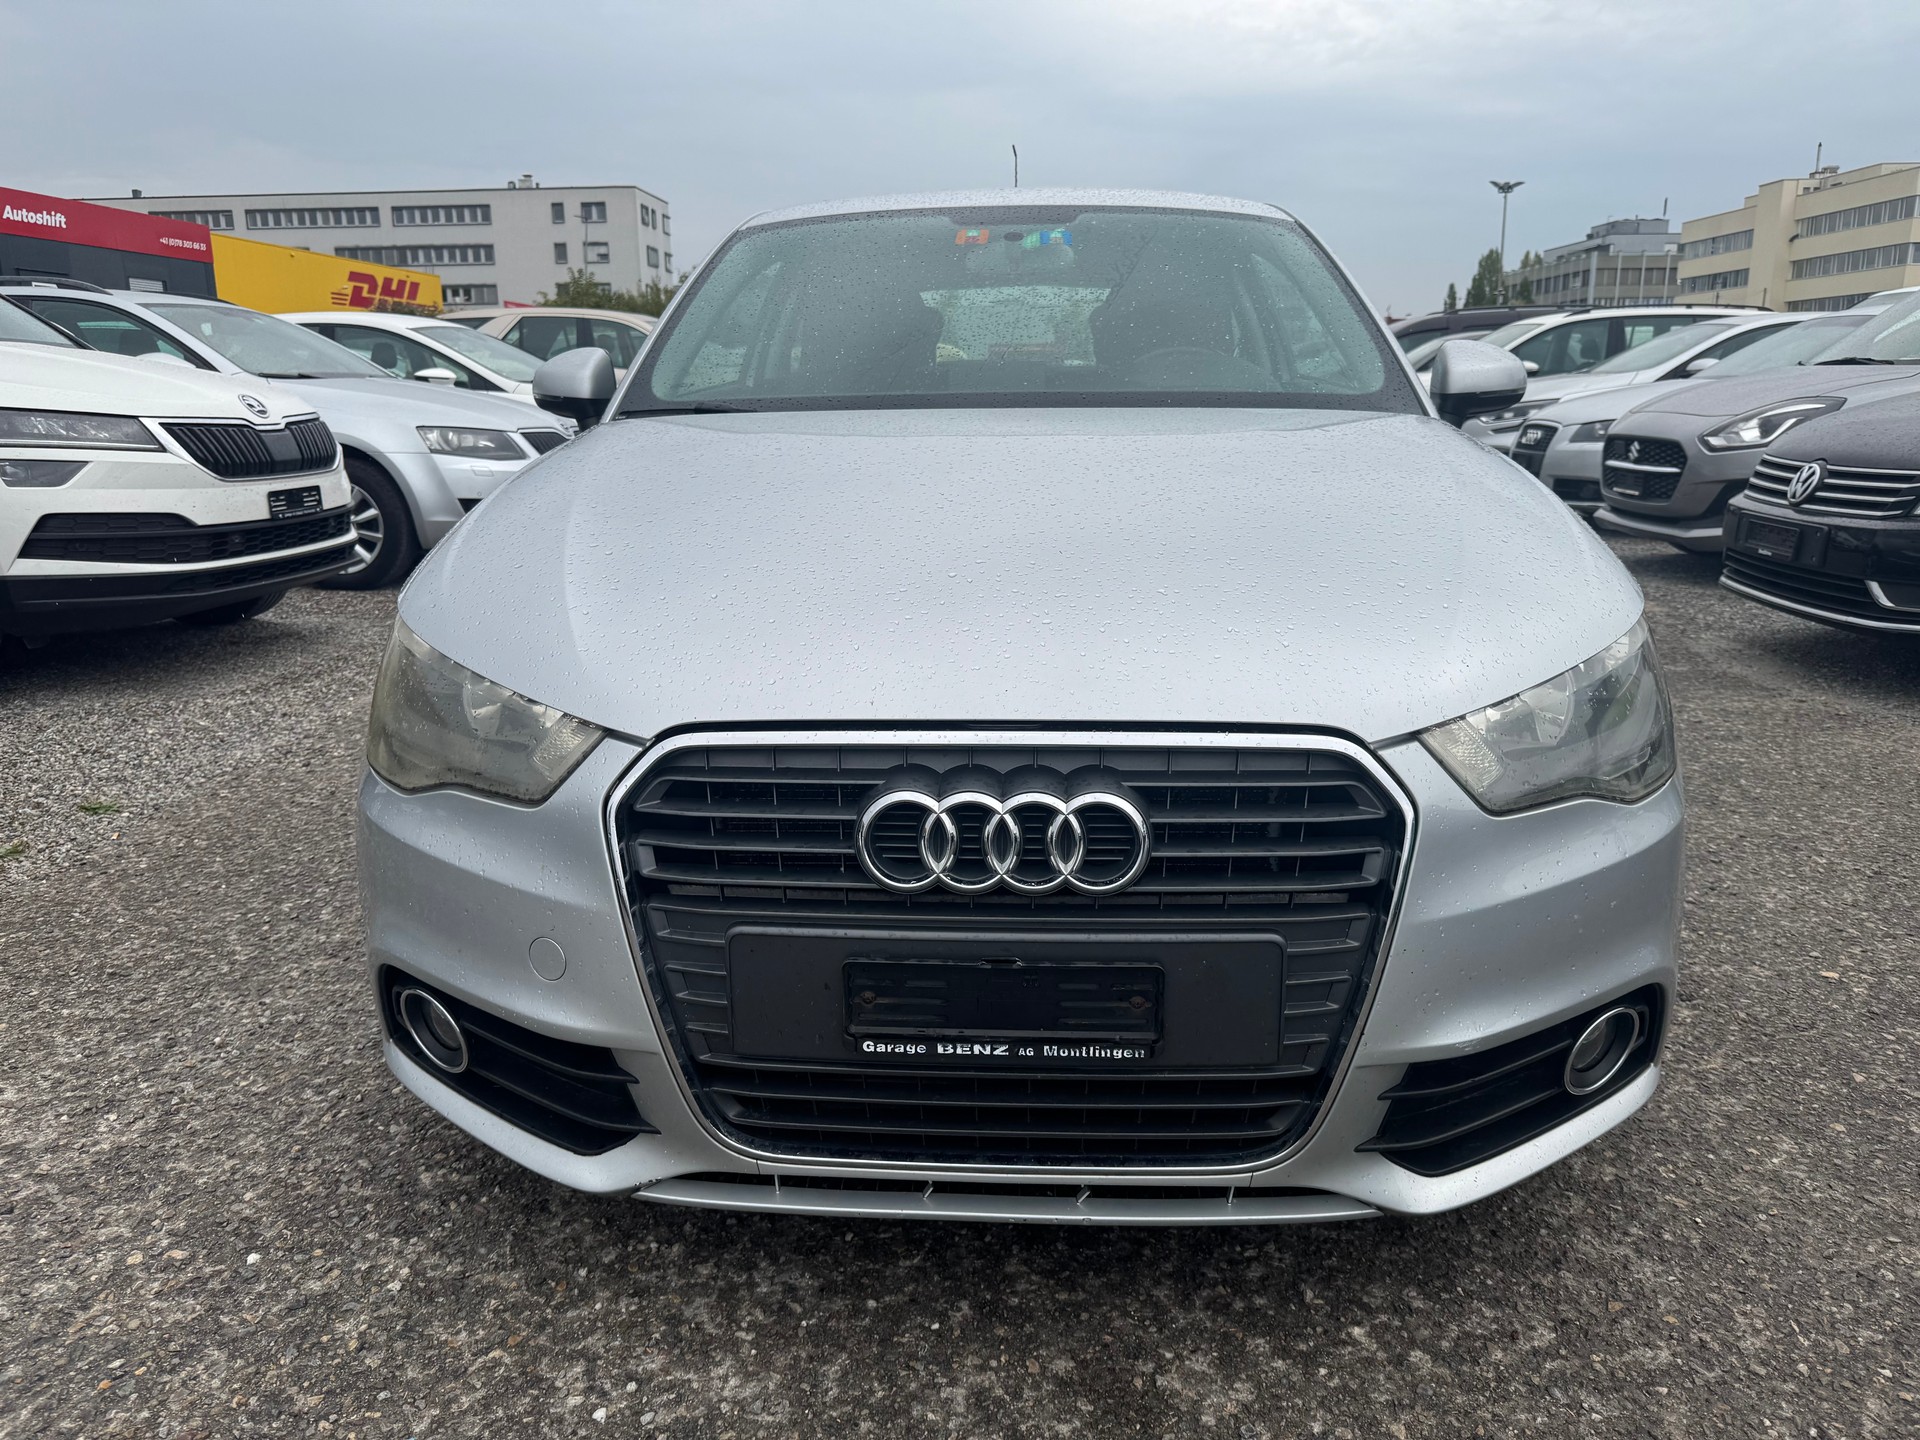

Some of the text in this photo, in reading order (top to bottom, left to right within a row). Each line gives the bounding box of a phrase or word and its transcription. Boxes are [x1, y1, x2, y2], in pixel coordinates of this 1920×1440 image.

[2, 205, 67, 229] Autoshift
[347, 271, 438, 309] DHL
[862, 1041, 1145, 1059] Garage BENZ AG Montlingen
